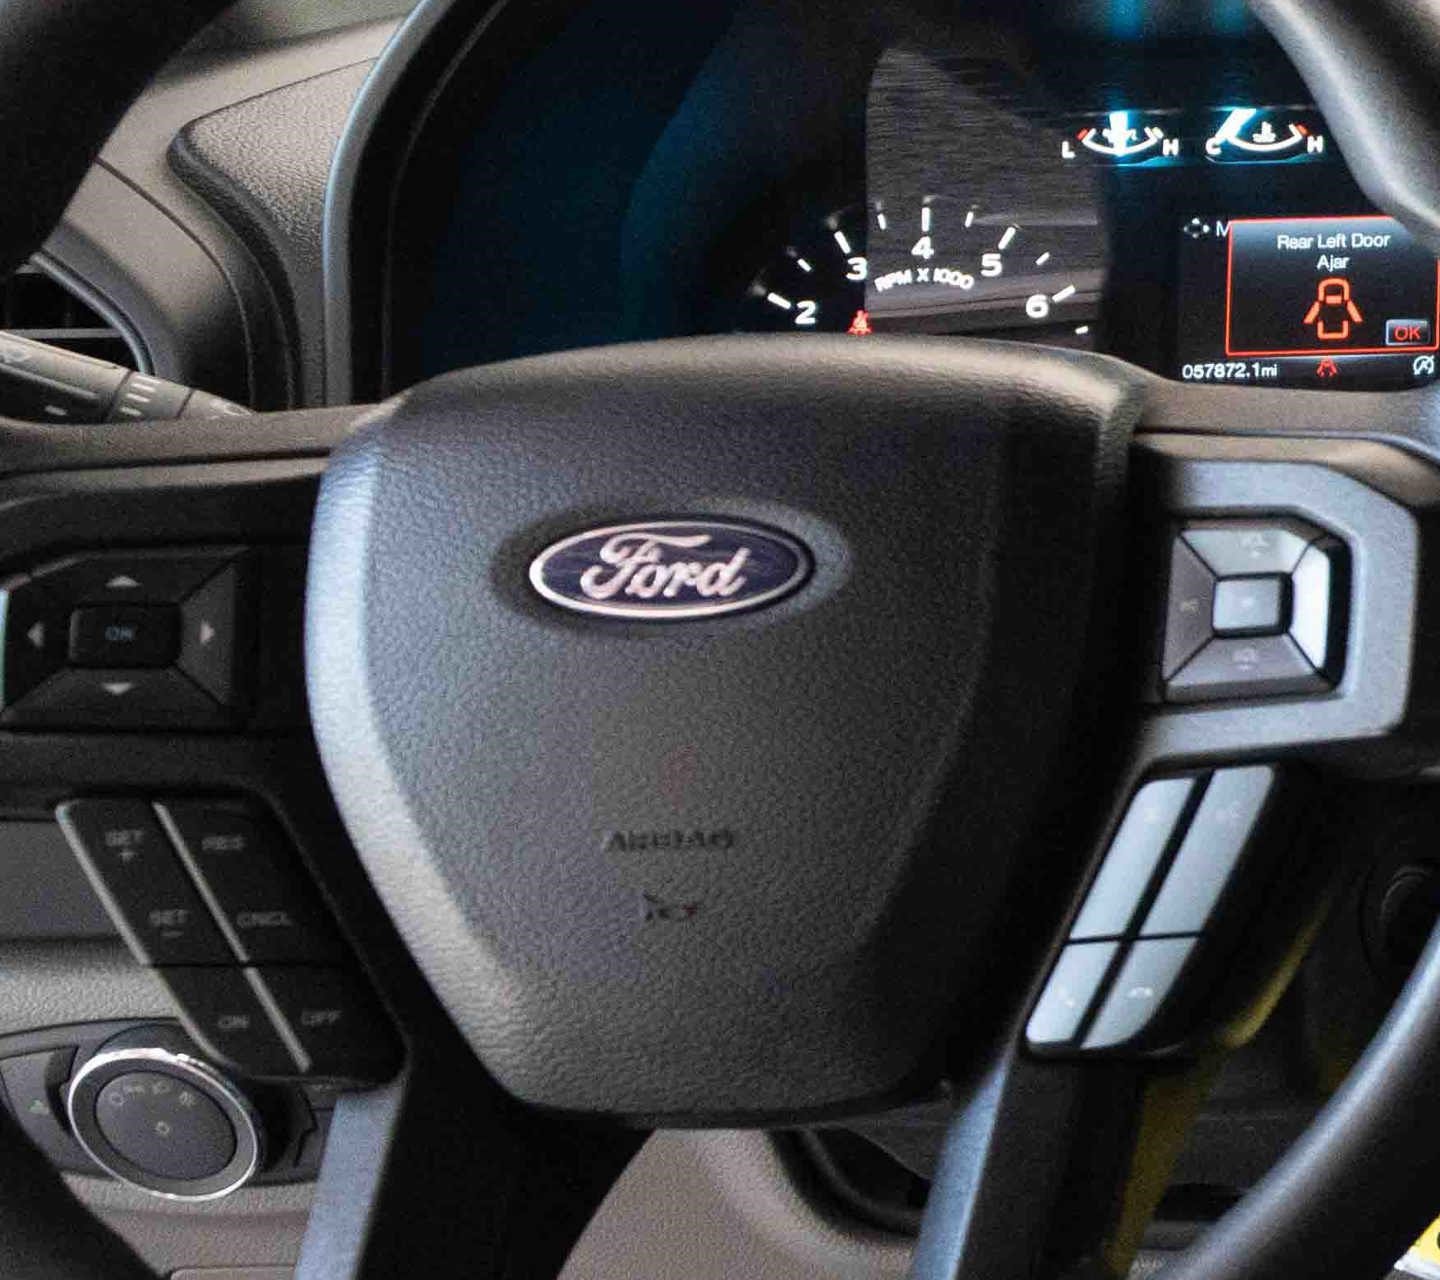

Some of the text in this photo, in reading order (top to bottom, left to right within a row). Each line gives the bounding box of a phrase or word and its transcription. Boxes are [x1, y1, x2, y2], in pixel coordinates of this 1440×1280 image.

[1061, 140, 1076, 158] L
[1162, 138, 1179, 155] H
[1307, 135, 1324, 153] H
[911, 236, 935, 260] 4
[1277, 233, 1391, 250] Rear Left Door
[846, 257, 868, 282] 3
[981, 253, 1002, 278] 5
[1316, 255, 1350, 273] Ajar
[874, 268, 914, 293] RPM
[932, 268, 975, 292] 1000
[794, 300, 817, 325] 2
[1026, 294, 1049, 319] 6
[1394, 324, 1422, 341] OK
[580, 532, 751, 599] Ford
